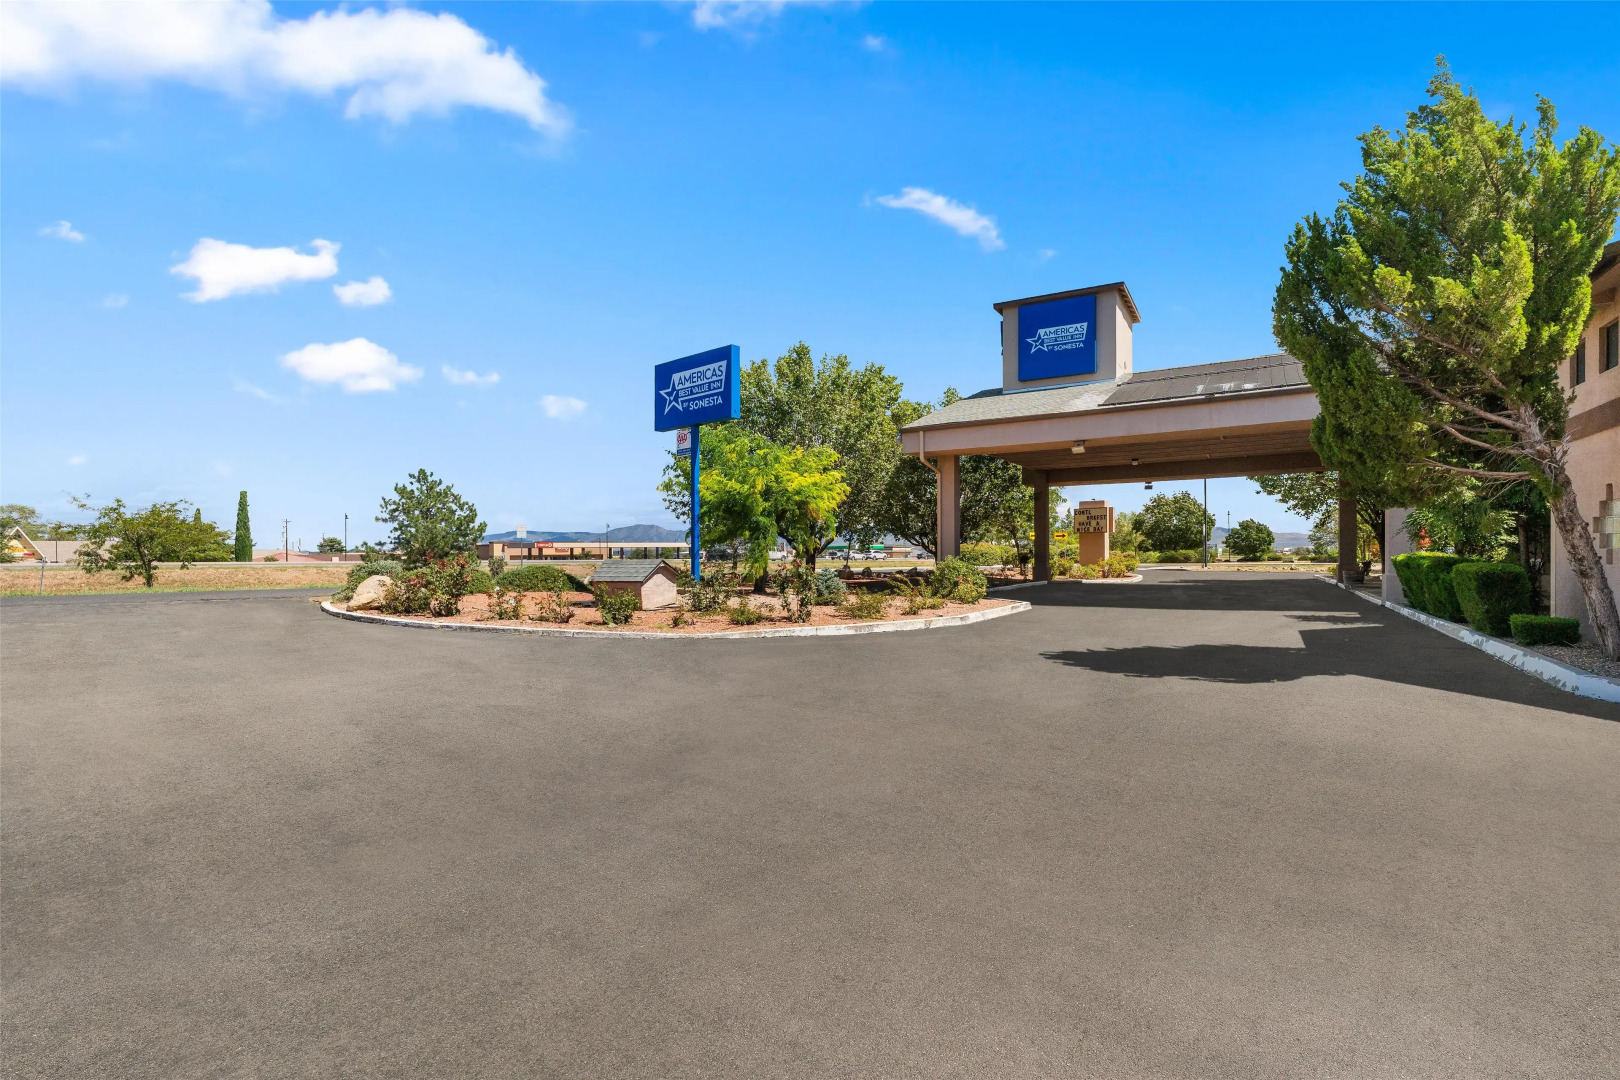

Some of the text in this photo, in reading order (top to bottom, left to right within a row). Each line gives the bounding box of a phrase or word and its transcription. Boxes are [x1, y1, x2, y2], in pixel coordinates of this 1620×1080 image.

[1042, 324, 1085, 337] AMERICAS
[1053, 342, 1084, 351] SONESTA
[677, 364, 723, 387] AMERICAS
[678, 380, 721, 397] BEST VALUE INN
[689, 395, 723, 410] SONESTA
